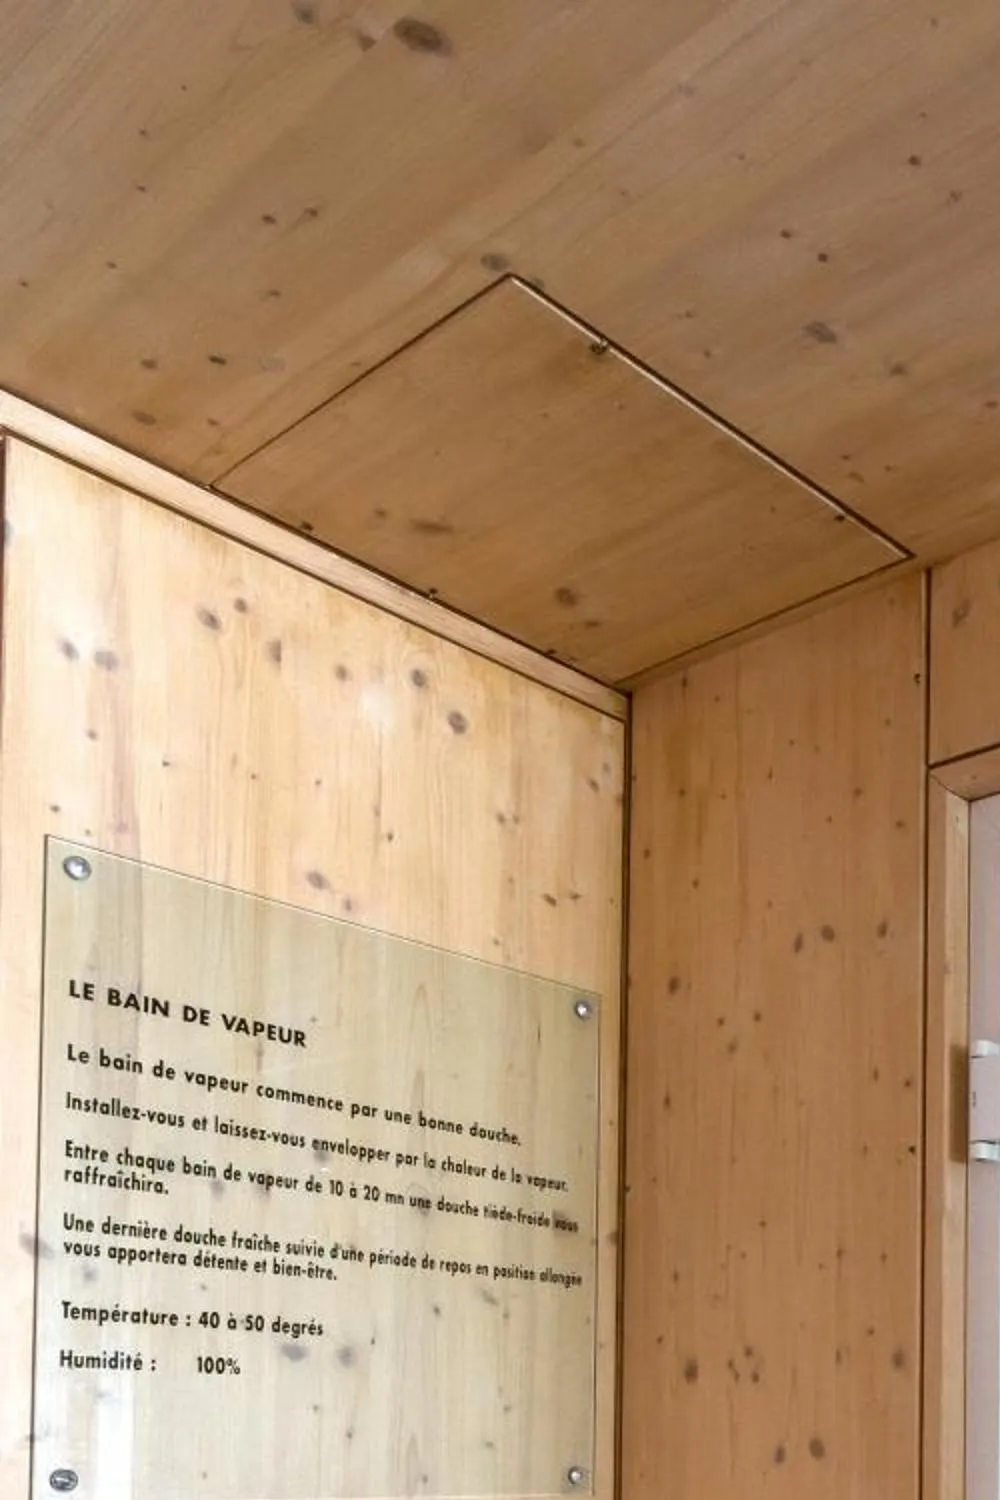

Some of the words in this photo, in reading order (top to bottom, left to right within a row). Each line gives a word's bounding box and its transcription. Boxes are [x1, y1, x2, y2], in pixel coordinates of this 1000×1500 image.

[68, 979, 95, 1001] LE
[106, 987, 170, 1017] BAIN
[182, 1005, 211, 1026] DE
[221, 1013, 307, 1048] VAPEUR
[67, 1043, 91, 1064] Le
[99, 1048, 143, 1074] bain
[152, 1060, 176, 1081] de
[184, 1071, 249, 1094] vapeur
[256, 1083, 343, 1112] commence
[350, 1101, 378, 1121] par
[384, 1109, 412, 1125] une
[418, 1110, 464, 1135] bonne
[469, 1122, 521, 1146] douche.
[65, 1091, 185, 1129] Installez-vous
[192, 1114, 208, 1131] et
[214, 1115, 312, 1150] laissez-vous
[312, 1136, 391, 1163] envelopper
[395, 1152, 419, 1168] par
[423, 1152, 437, 1169] la
[441, 1155, 487, 1179] chaleur
[491, 1165, 507, 1182] de
[511, 1167, 523, 1183] la
[527, 1175, 569, 1193] vapeur.
[64, 1139, 109, 1164] Entre
[116, 1147, 176, 1175] chaque
[182, 1156, 217, 1179] bain
[223, 1162, 242, 1182] de
[247, 1170, 299, 1191] vapeur
[305, 1178, 322, 1194] de
[329, 1179, 344, 1198] 10
[363, 1184, 381, 1202] 20
[385, 1192, 405, 1206] mn
[409, 1195, 432, 1210] une
[437, 1195, 479, 1217] douche
[64, 1165, 169, 1196] raffraîchira.
[63, 1212, 95, 1233] Une
[101, 1216, 167, 1242] dernière
[173, 1224, 227, 1248] douche
[231, 1228, 281, 1253] fraîche
[285, 1238, 325, 1259] suivie
[330, 1243, 365, 1262] d'une
[369, 1248, 417, 1268] période
[421, 1253, 436, 1270] de
[439, 1260, 471, 1277] repos
[475, 1263, 489, 1277] en
[63, 1242, 101, 1257] vous
[107, 1245, 187, 1266] apportera
[193, 1248, 248, 1272] détente
[253, 1257, 267, 1273] et
[272, 1258, 338, 1281] bien-être.
[61, 1300, 179, 1327] Température
[198, 1311, 220, 1329] 40
[227, 1312, 237, 1330] à
[245, 1314, 264, 1332] 50
[271, 1316, 324, 1338] degrés
[60, 1349, 143, 1372] Humidité
[197, 1356, 241, 1375] 100%
